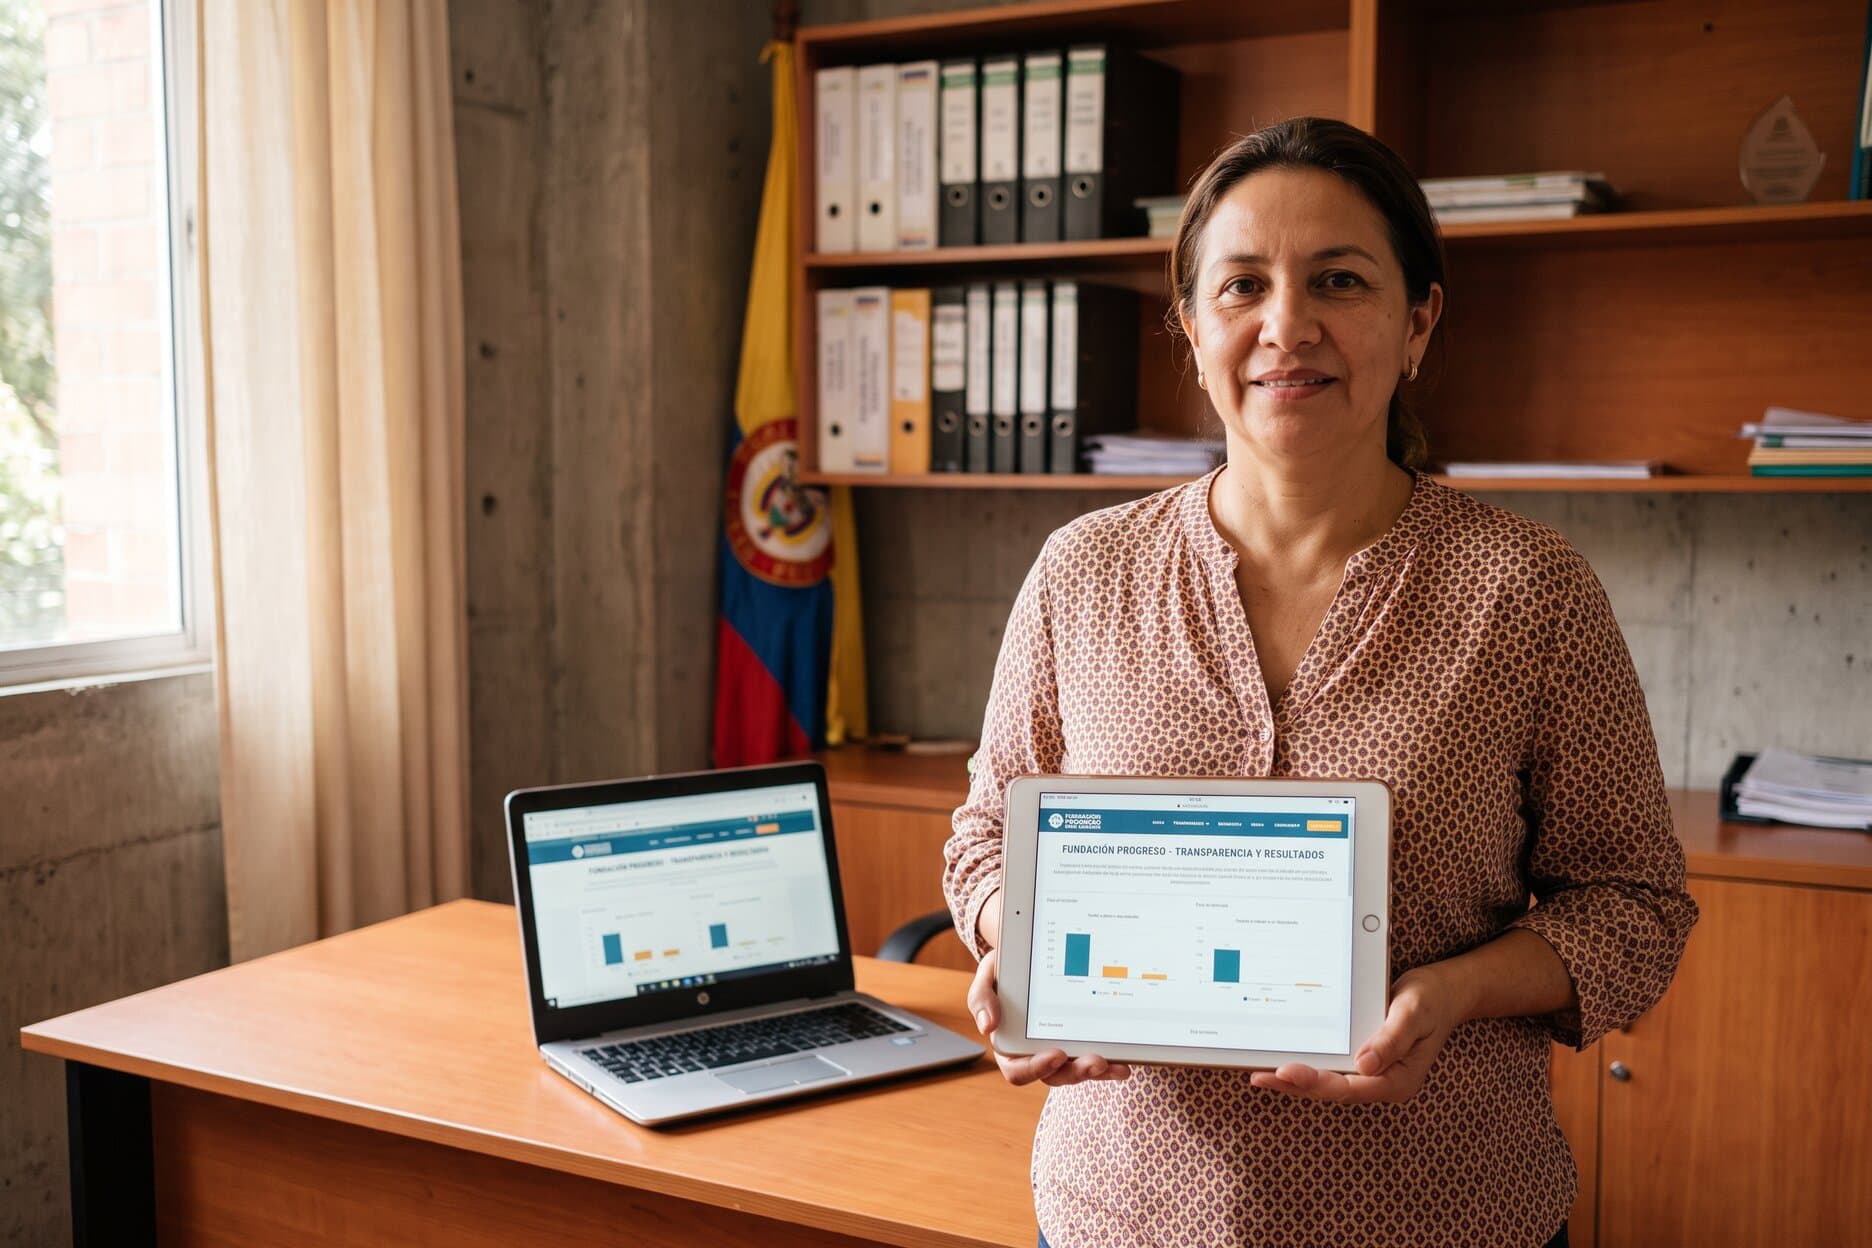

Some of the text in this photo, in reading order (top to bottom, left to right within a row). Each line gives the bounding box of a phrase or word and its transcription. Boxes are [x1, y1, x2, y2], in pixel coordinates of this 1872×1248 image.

[1062, 844, 1115, 855] FUNDACIÓN
[1117, 846, 1166, 856] PROGRESO
[1175, 847, 1253, 858] TRANSPARENCIA
[1255, 848, 1262, 858] Y
[1264, 849, 1325, 860] RESULTADOS
